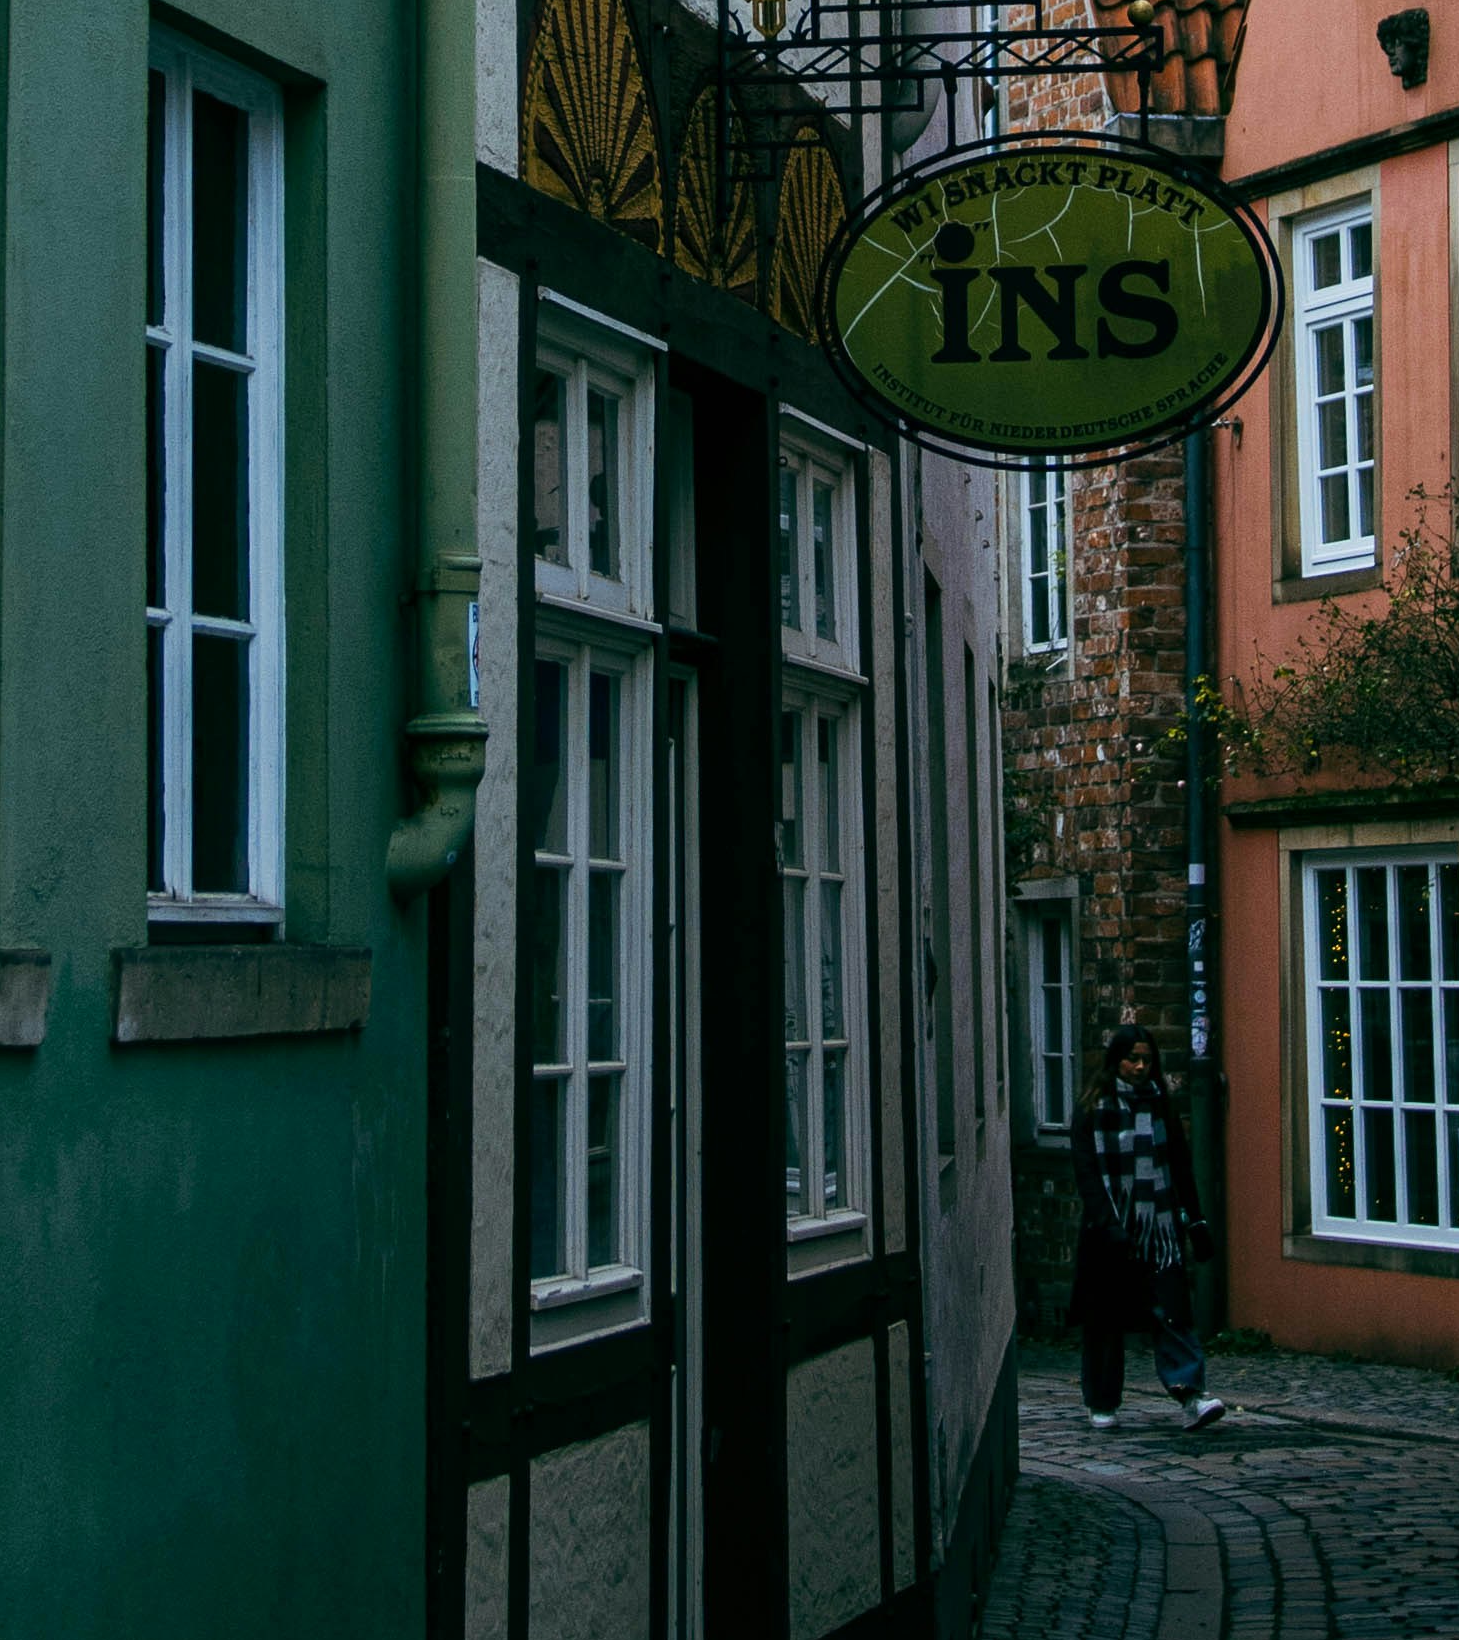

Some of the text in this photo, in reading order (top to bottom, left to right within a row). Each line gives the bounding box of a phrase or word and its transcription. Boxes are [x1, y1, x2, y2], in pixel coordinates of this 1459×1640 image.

[889, 161, 1206, 235] WI SNACKT PLATT
[871, 363, 948, 421] INSTITUT
[948, 411, 986, 435] FÜR
[1155, 352, 1230, 414] SPRACHE
